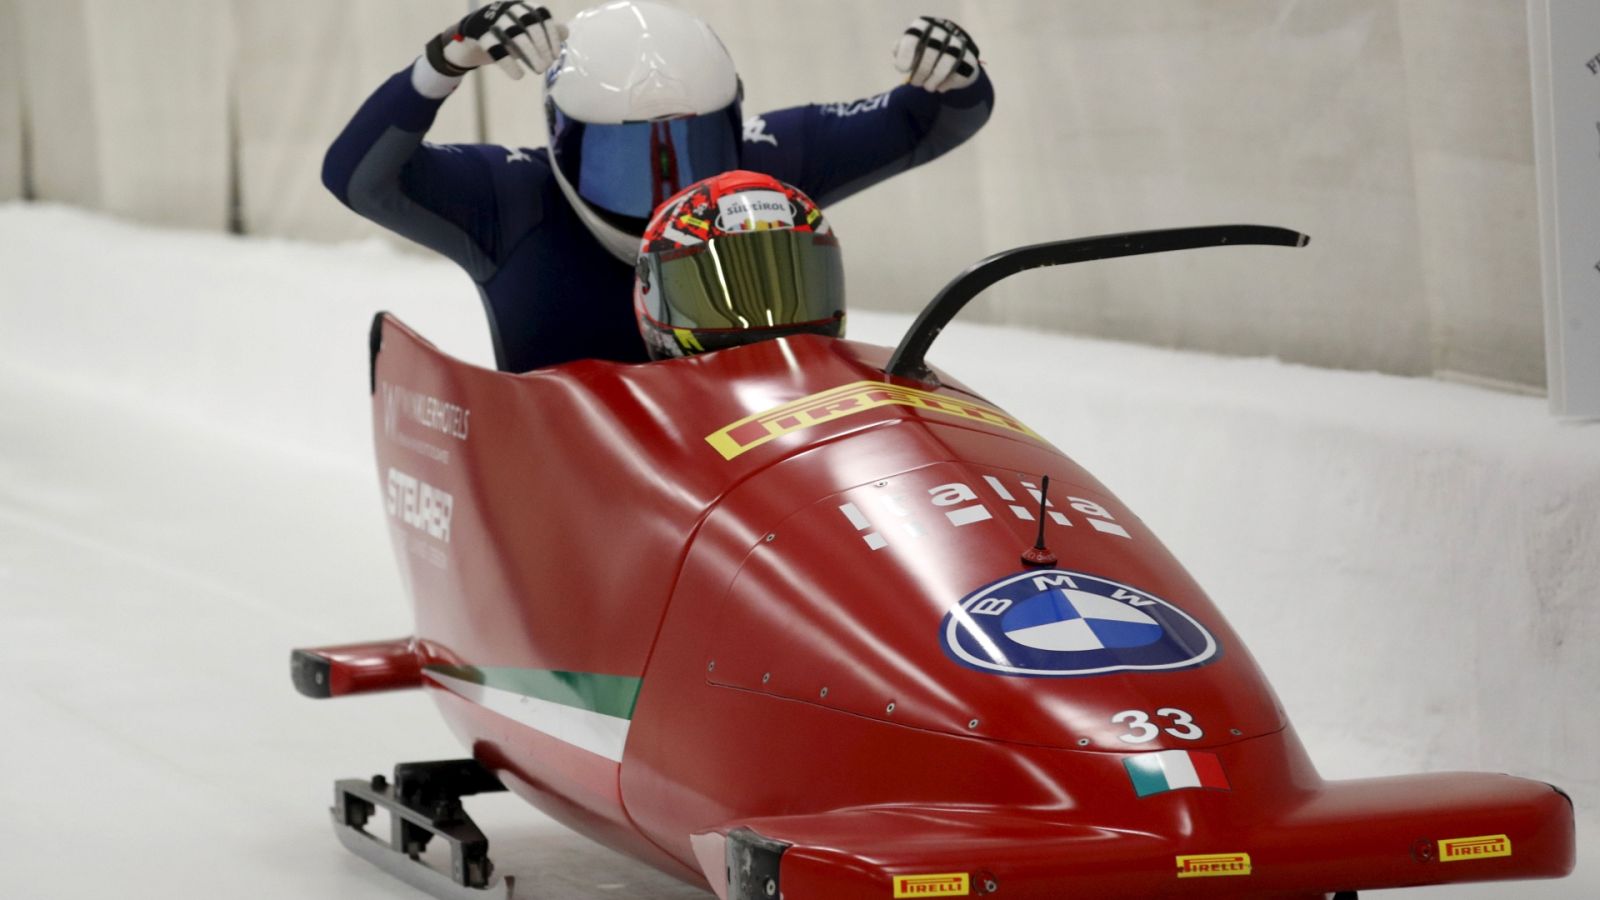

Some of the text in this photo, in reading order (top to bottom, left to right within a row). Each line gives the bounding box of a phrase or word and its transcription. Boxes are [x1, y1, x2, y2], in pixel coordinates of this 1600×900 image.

[970, 575, 1157, 616] BMW
[1111, 707, 1203, 744] 33
[1446, 838, 1505, 857] PIRELLI
[1183, 856, 1244, 873] PIRELLI
[901, 877, 962, 894] PIRELLI
